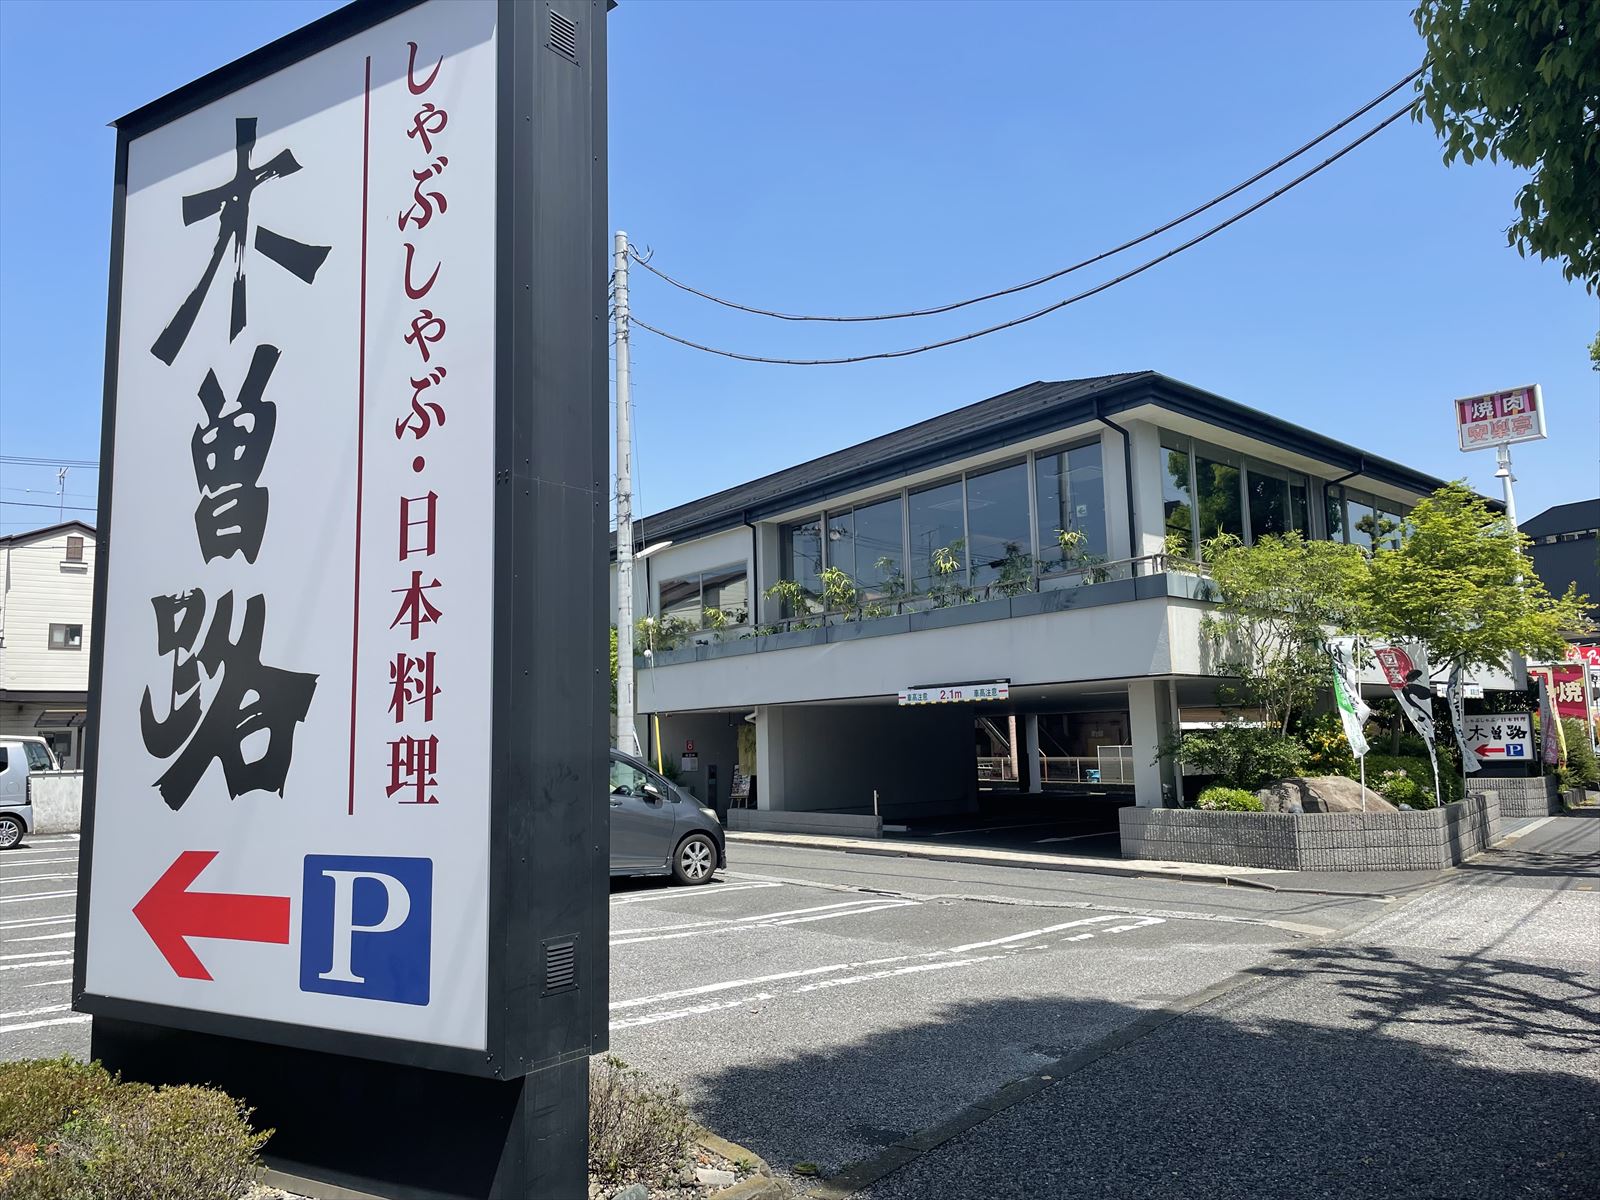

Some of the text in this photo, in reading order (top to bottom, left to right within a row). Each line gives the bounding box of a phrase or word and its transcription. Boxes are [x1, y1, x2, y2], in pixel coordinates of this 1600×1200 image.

[1472, 396, 1524, 418] 焼肉
[385, 41, 448, 805] しゃぶしゃぶ・日本料理
[140, 117, 332, 811] 木曽路
[940, 689, 962, 700] 2.1m
[974, 687, 998, 698] 車高注意
[1467, 725, 1527, 741] 木曽路
[1509, 745, 1521, 756] P
[318, 869, 412, 984] P
